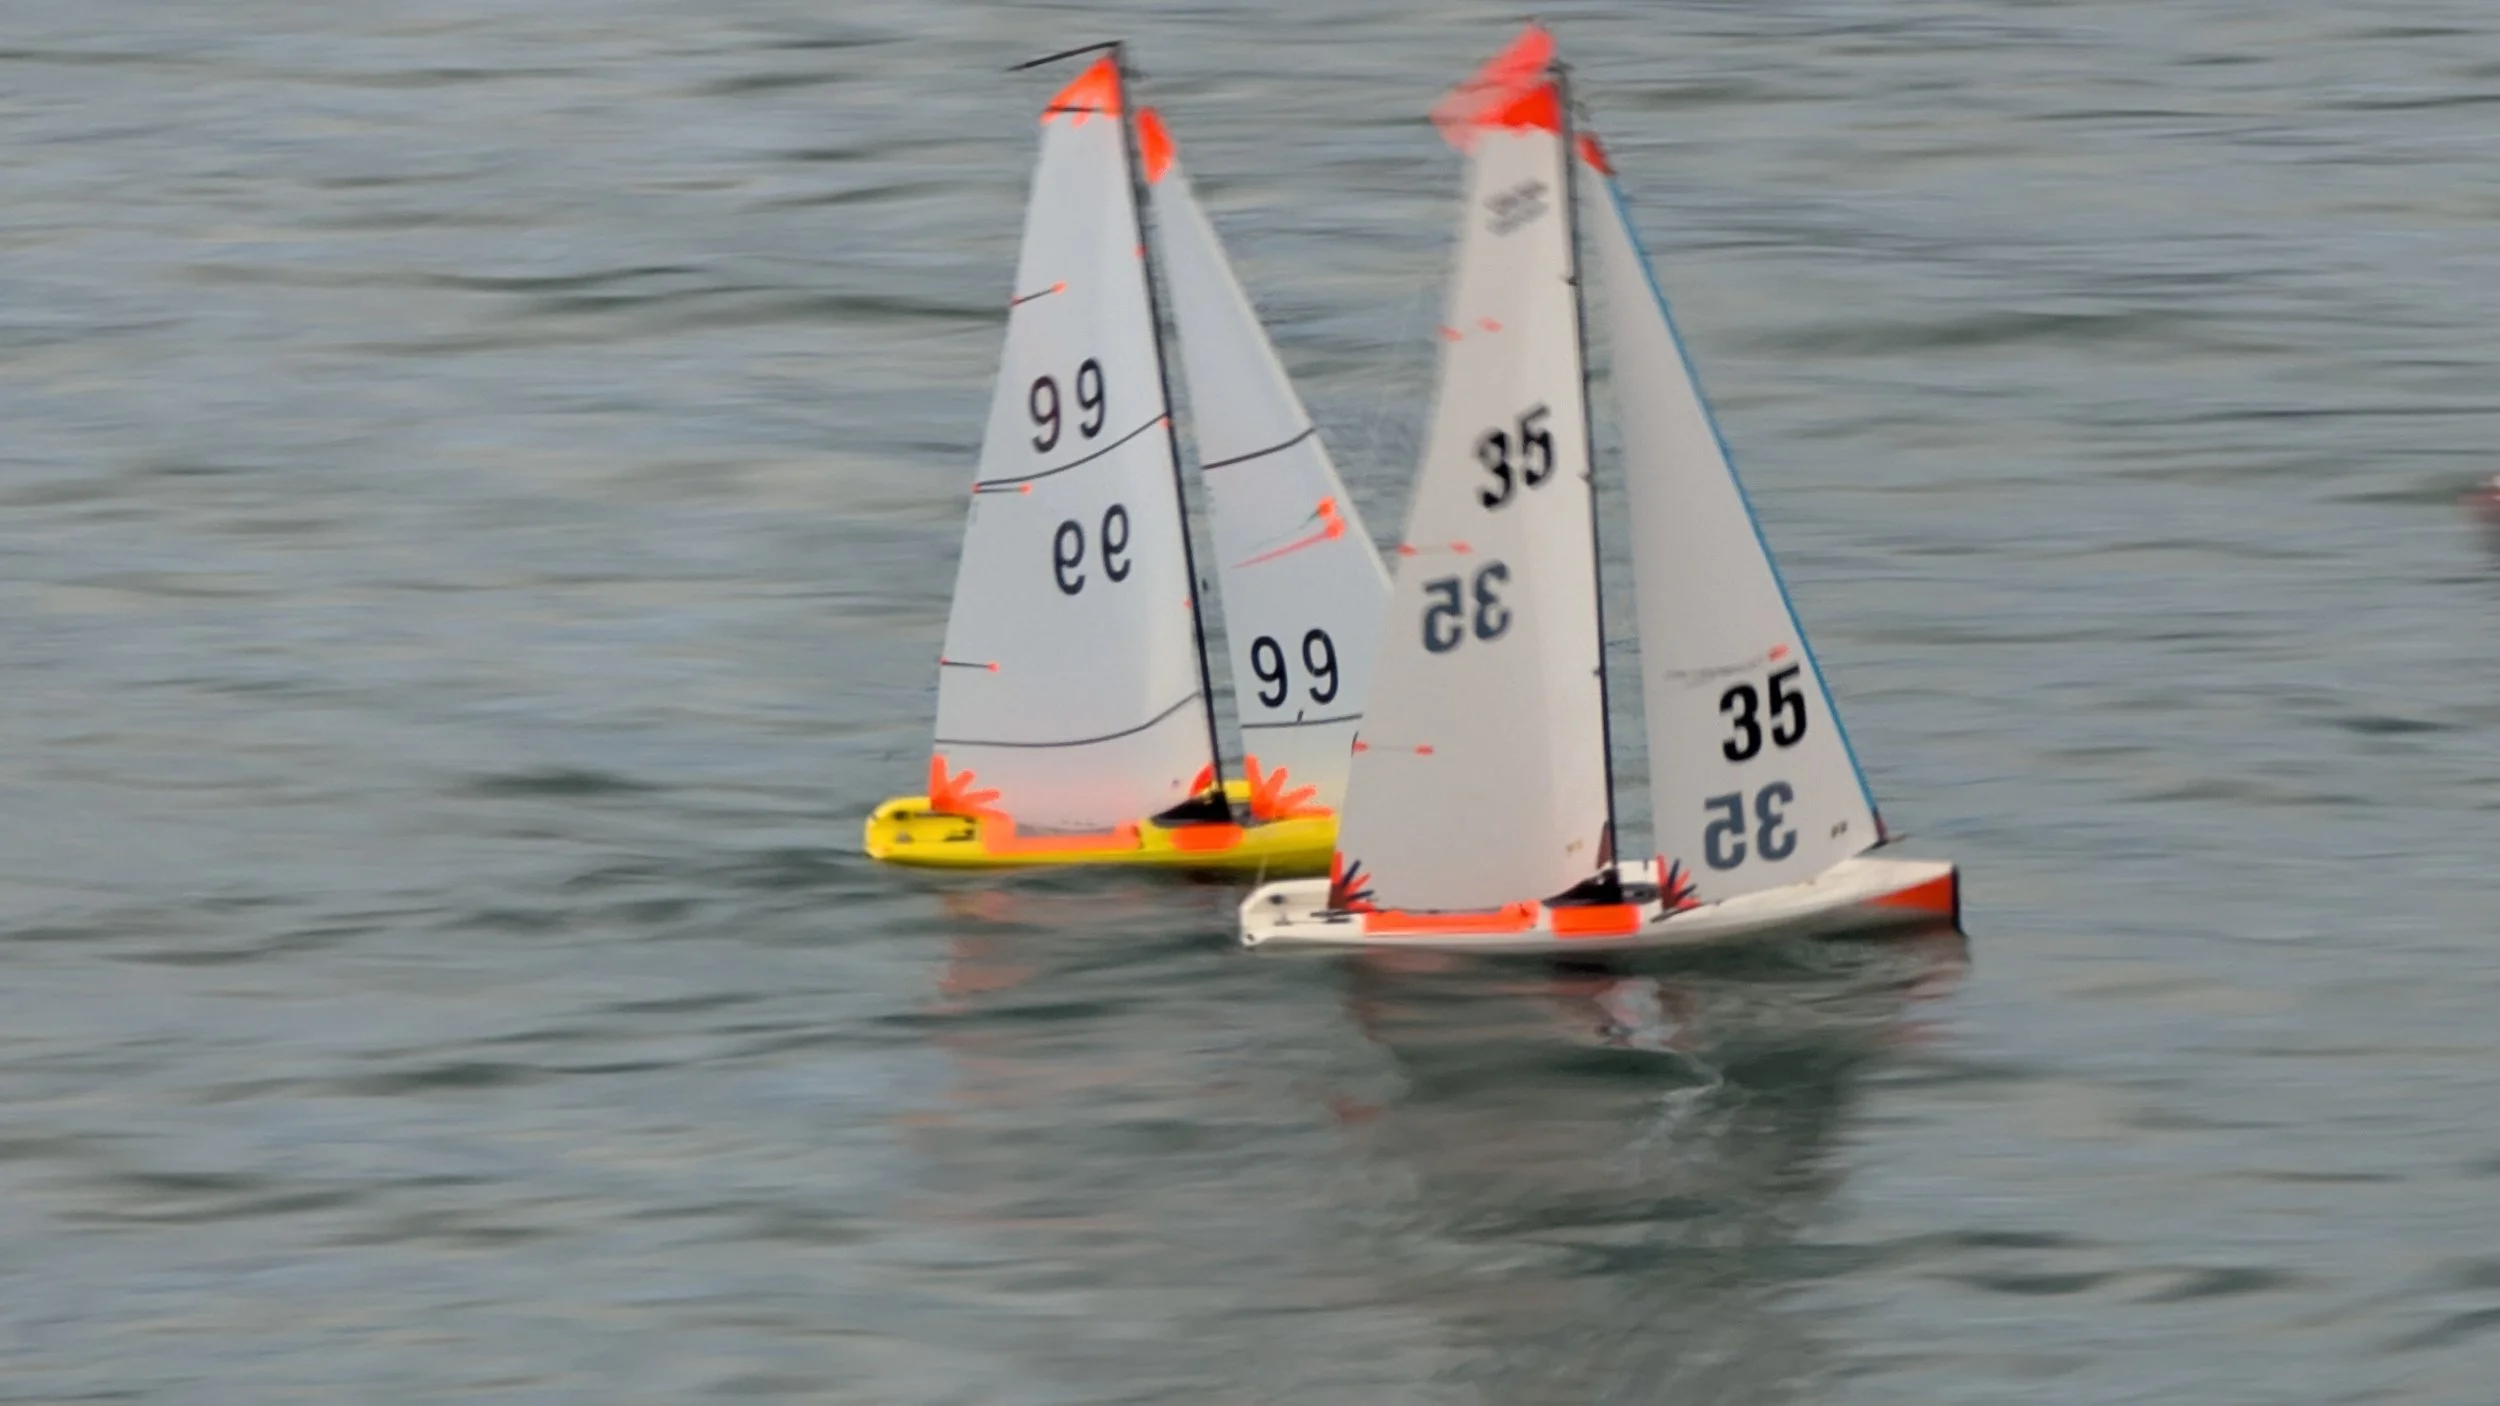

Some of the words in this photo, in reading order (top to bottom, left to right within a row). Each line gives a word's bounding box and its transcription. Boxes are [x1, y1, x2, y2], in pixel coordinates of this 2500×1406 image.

[1028, 357, 1106, 453] 99
[1474, 404, 1557, 510] 35
[1250, 628, 1340, 708] 99
[1718, 662, 1808, 763] 35
